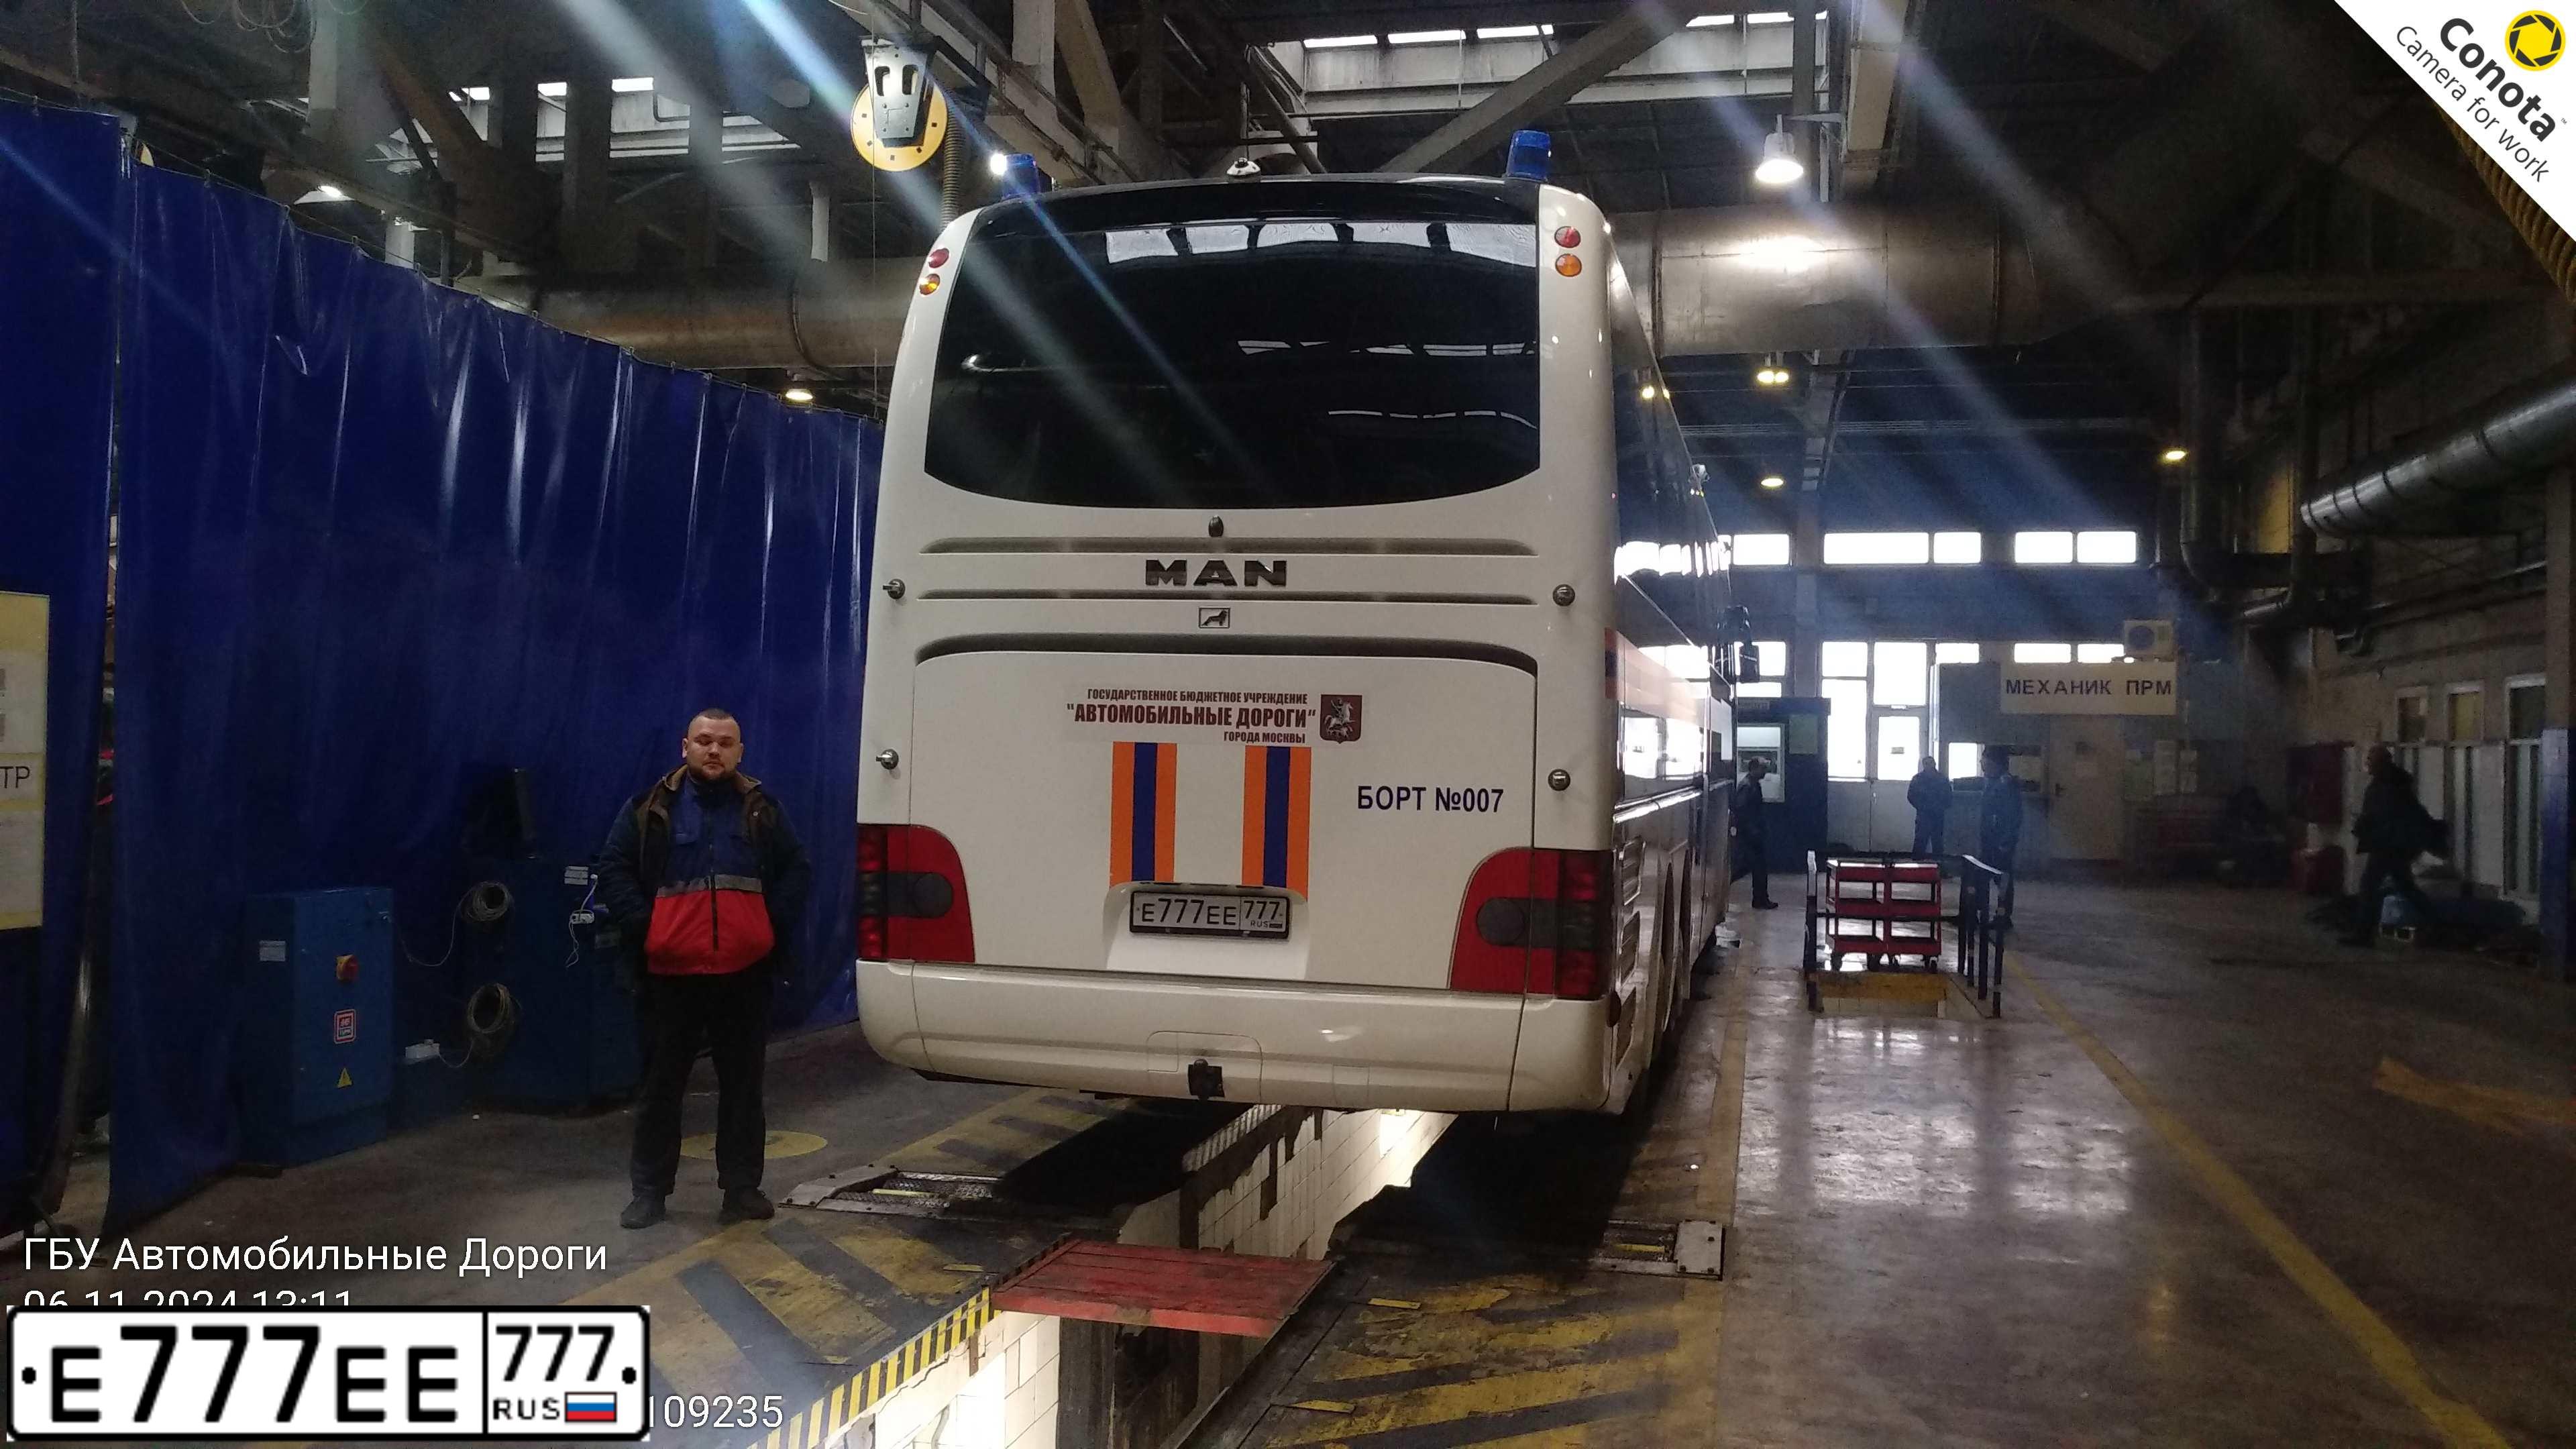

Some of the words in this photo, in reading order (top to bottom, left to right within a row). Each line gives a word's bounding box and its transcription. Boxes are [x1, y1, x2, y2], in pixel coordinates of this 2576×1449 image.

[1146, 559, 1287, 587] MAN
[2006, 679, 2112, 696] МЕХАНИК
[2126, 680, 2171, 696] ПРМ
[1087, 688, 1177, 702] ГОСУДАРСТВЕННОЕ
[1179, 690, 1242, 703] БЮДЖЕТНОЕ
[1243, 692, 1308, 705] УЧРЕЖДЕНИЕ
[1224, 731, 1260, 743] ГОРОДА
[1262, 732, 1305, 744] МОСКВЫ
[1358, 786, 1427, 811] БОРТ
[1435, 787, 1504, 813] №007
[1142, 898, 1236, 926] Е777ЕЕ
[1244, 900, 1280, 920] 777
[1250, 920, 1269, 928] RUS
